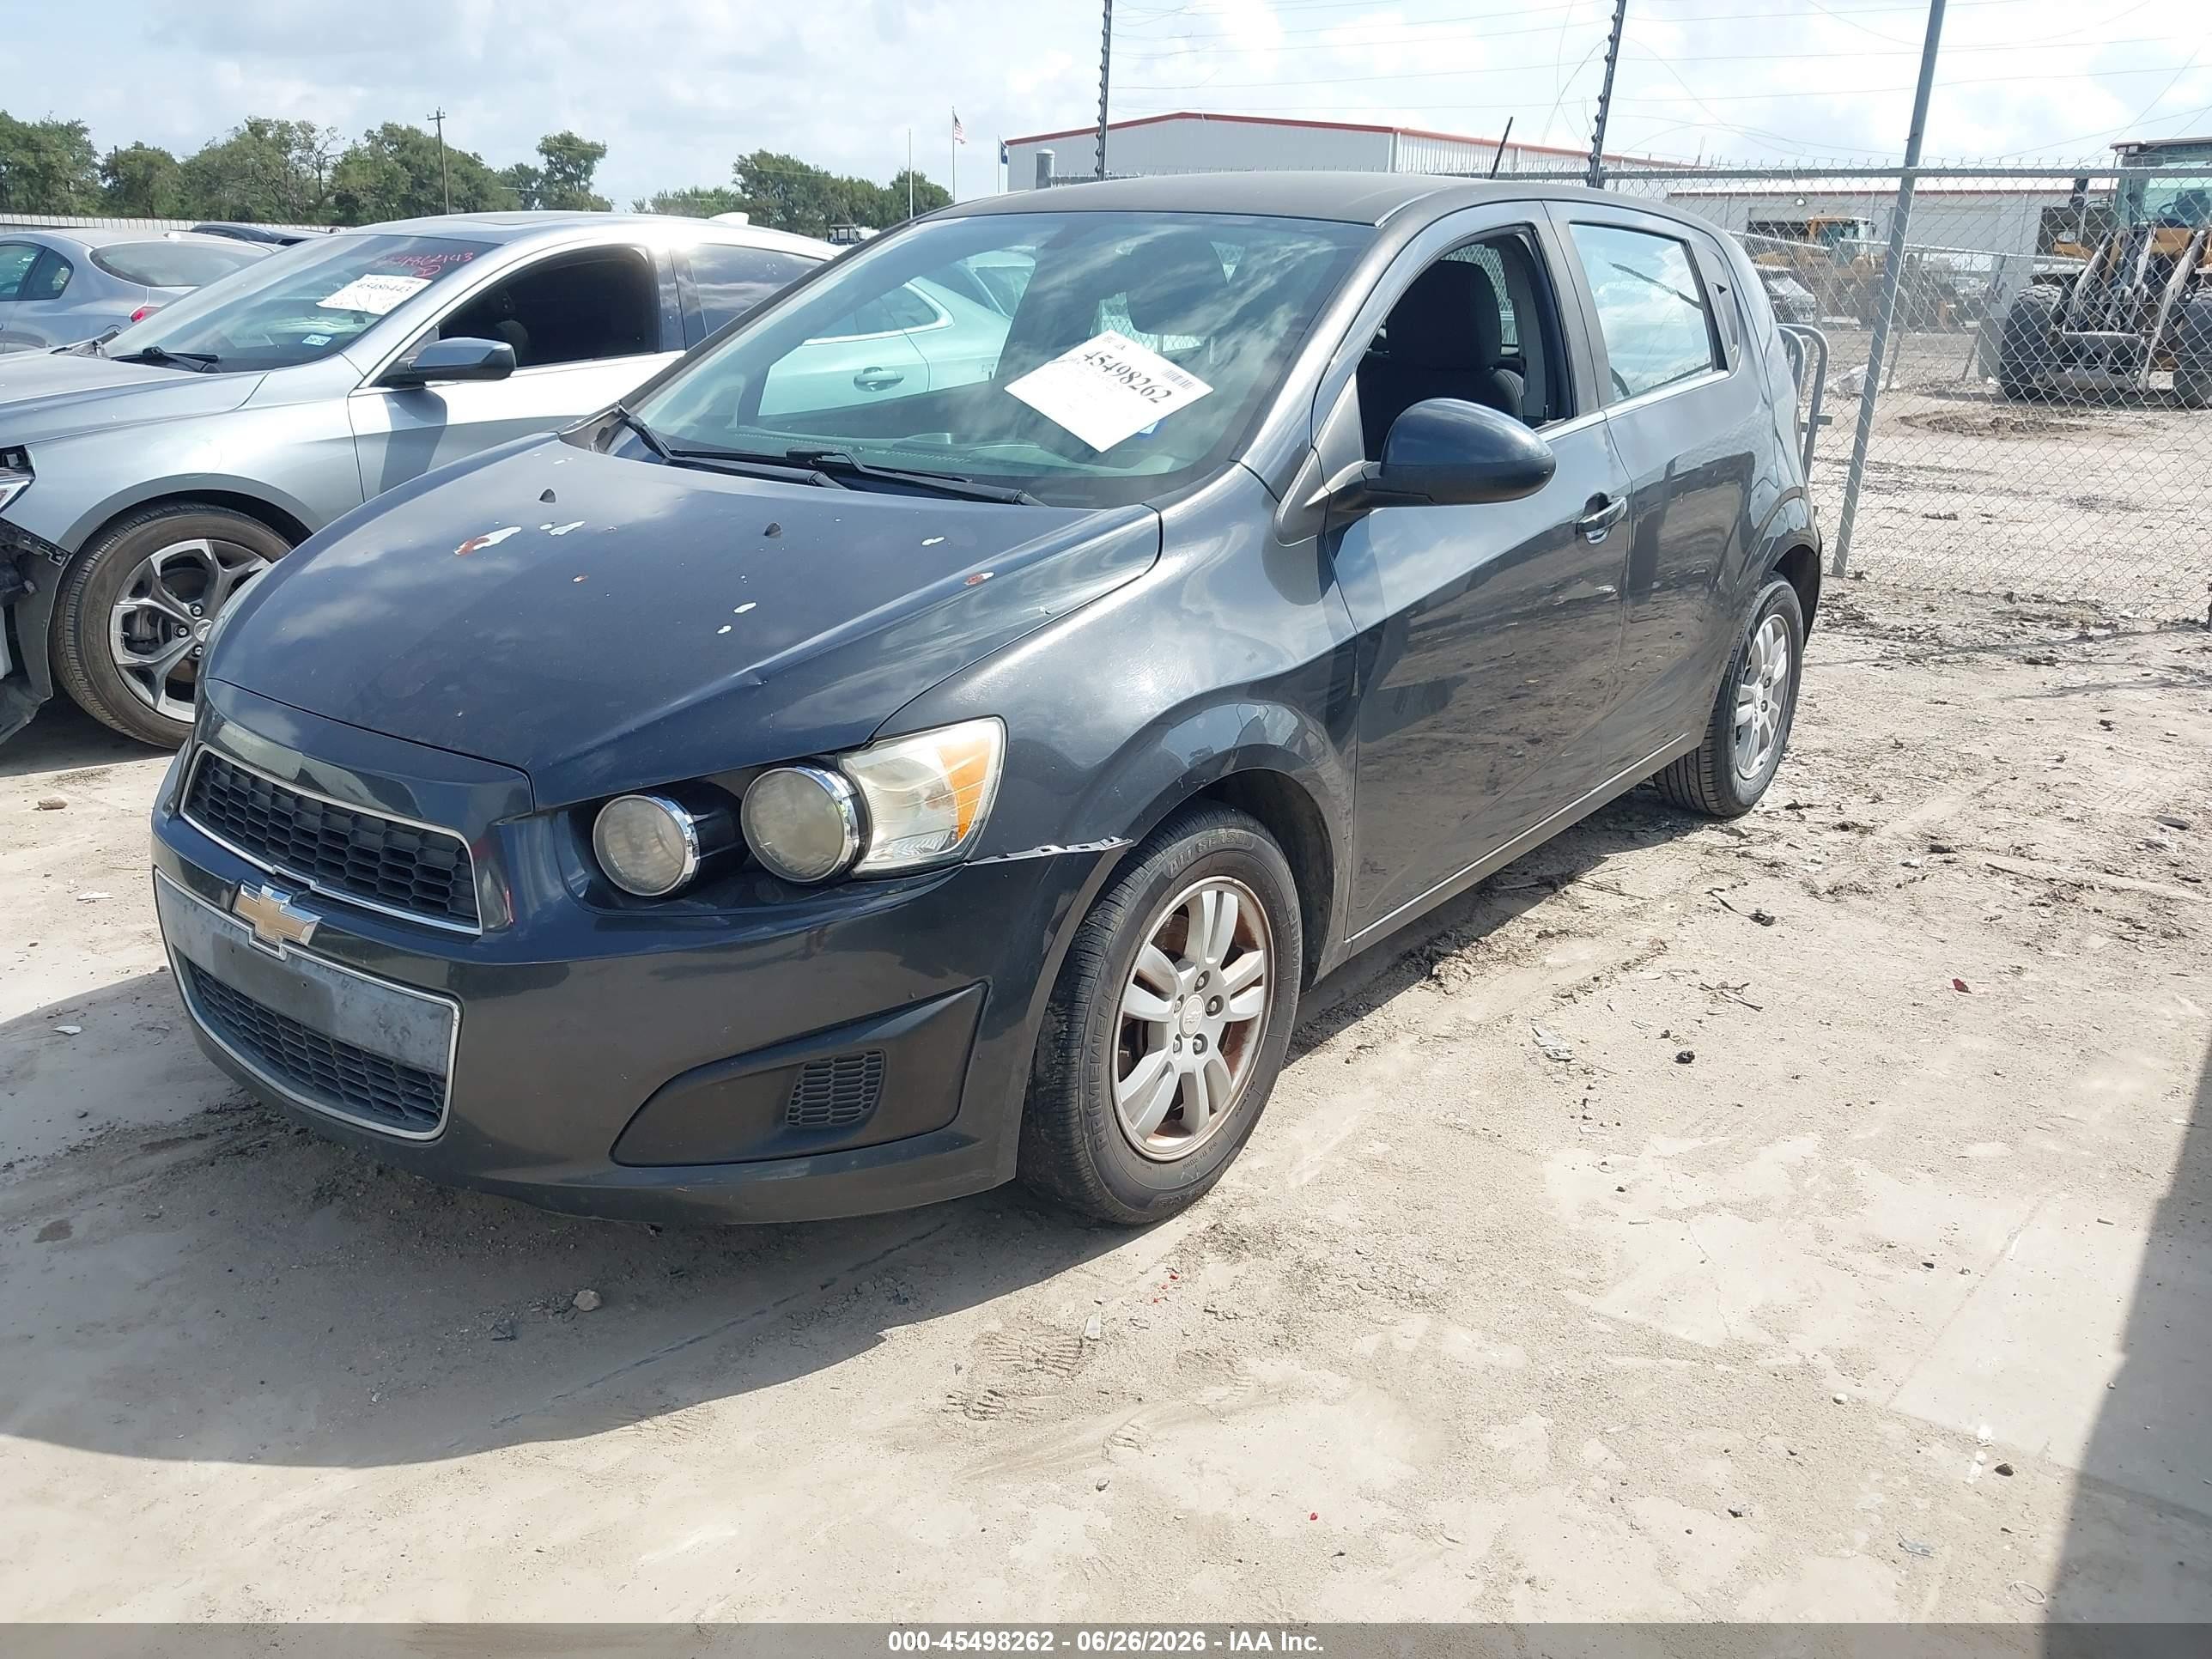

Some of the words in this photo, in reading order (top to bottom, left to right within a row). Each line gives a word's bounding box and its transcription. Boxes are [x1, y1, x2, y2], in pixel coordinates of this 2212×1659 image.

[1083, 350, 1172, 404] 45498262
[1195, 830, 1254, 853] SEASON
[1086, 983, 1115, 1152] PRIMEWELL
